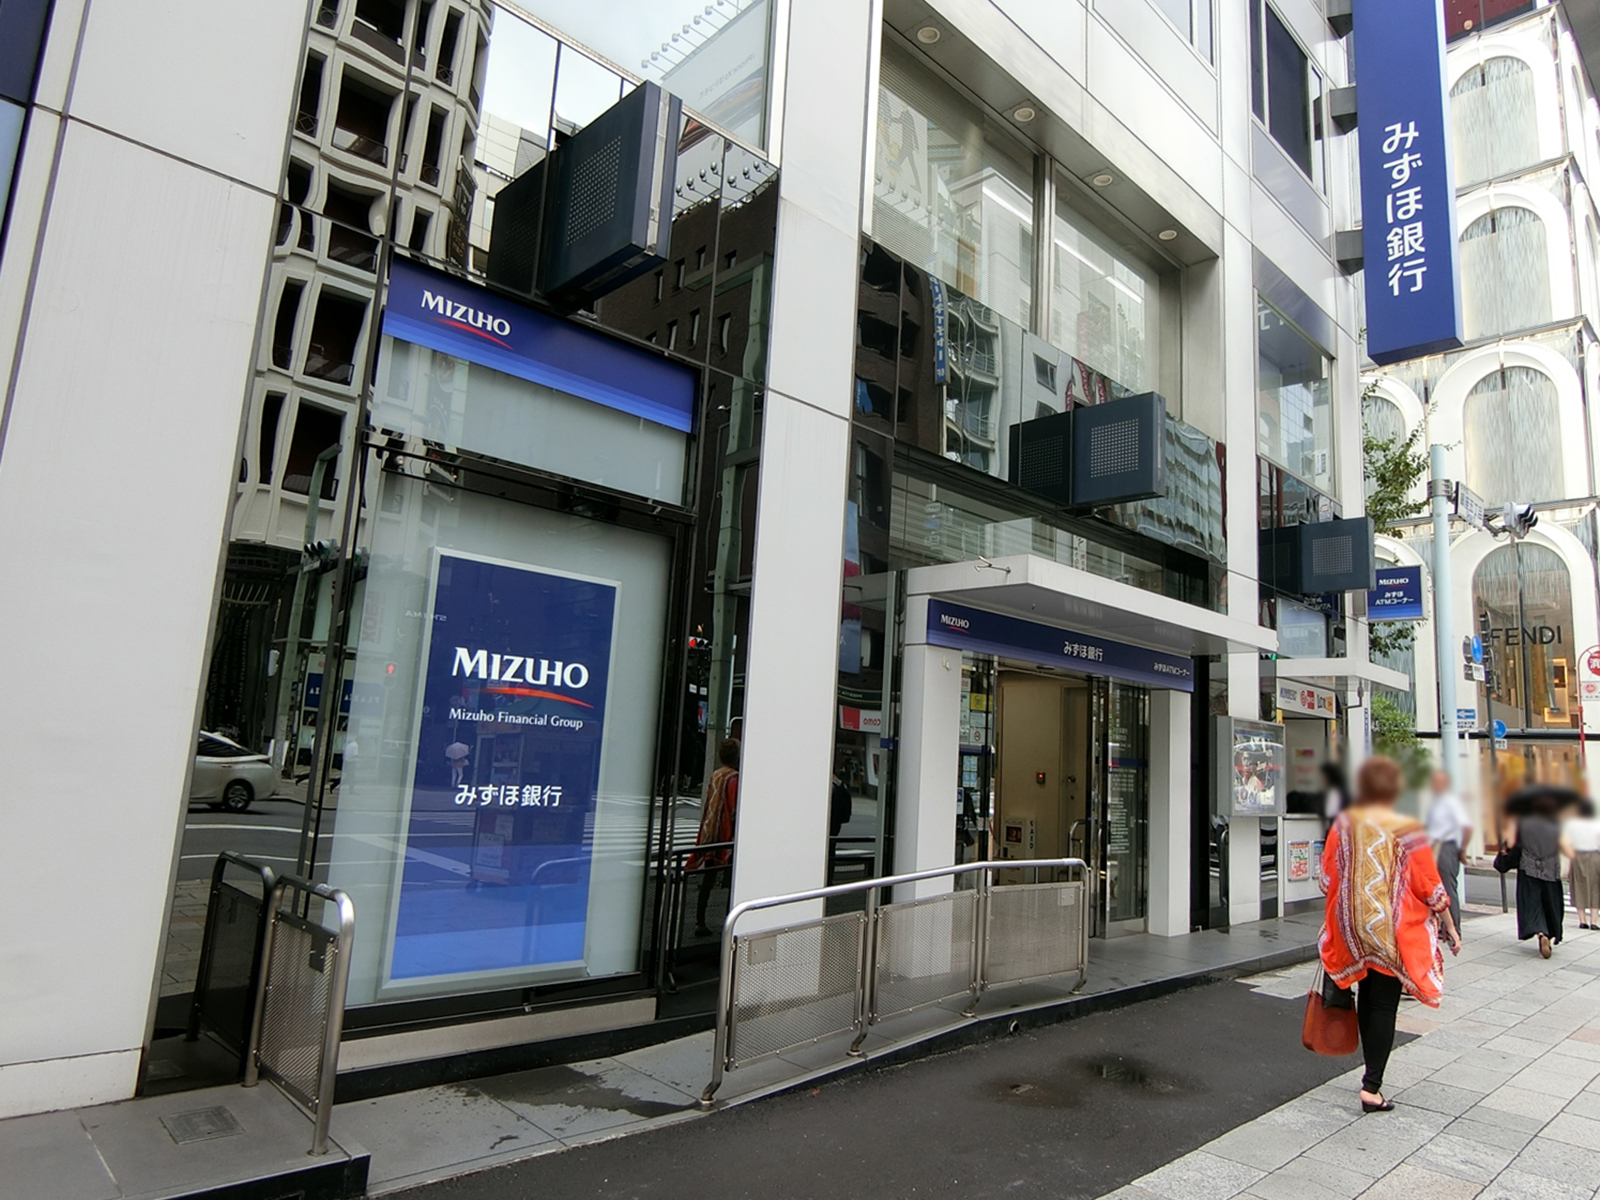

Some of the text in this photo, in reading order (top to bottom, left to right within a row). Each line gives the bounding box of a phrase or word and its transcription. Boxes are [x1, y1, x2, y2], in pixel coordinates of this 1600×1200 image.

[1382, 121, 1427, 297] みずほ銀行
[421, 290, 511, 337] MIZUHO
[940, 614, 970, 629] MIZUHO
[1490, 626, 1562, 646] FENDI
[1063, 641, 1103, 662] みずほ銀行
[452, 647, 589, 689] MIZUHO
[449, 708, 583, 731] Mizuho Financial Group
[454, 784, 563, 808] みずほ銀行
